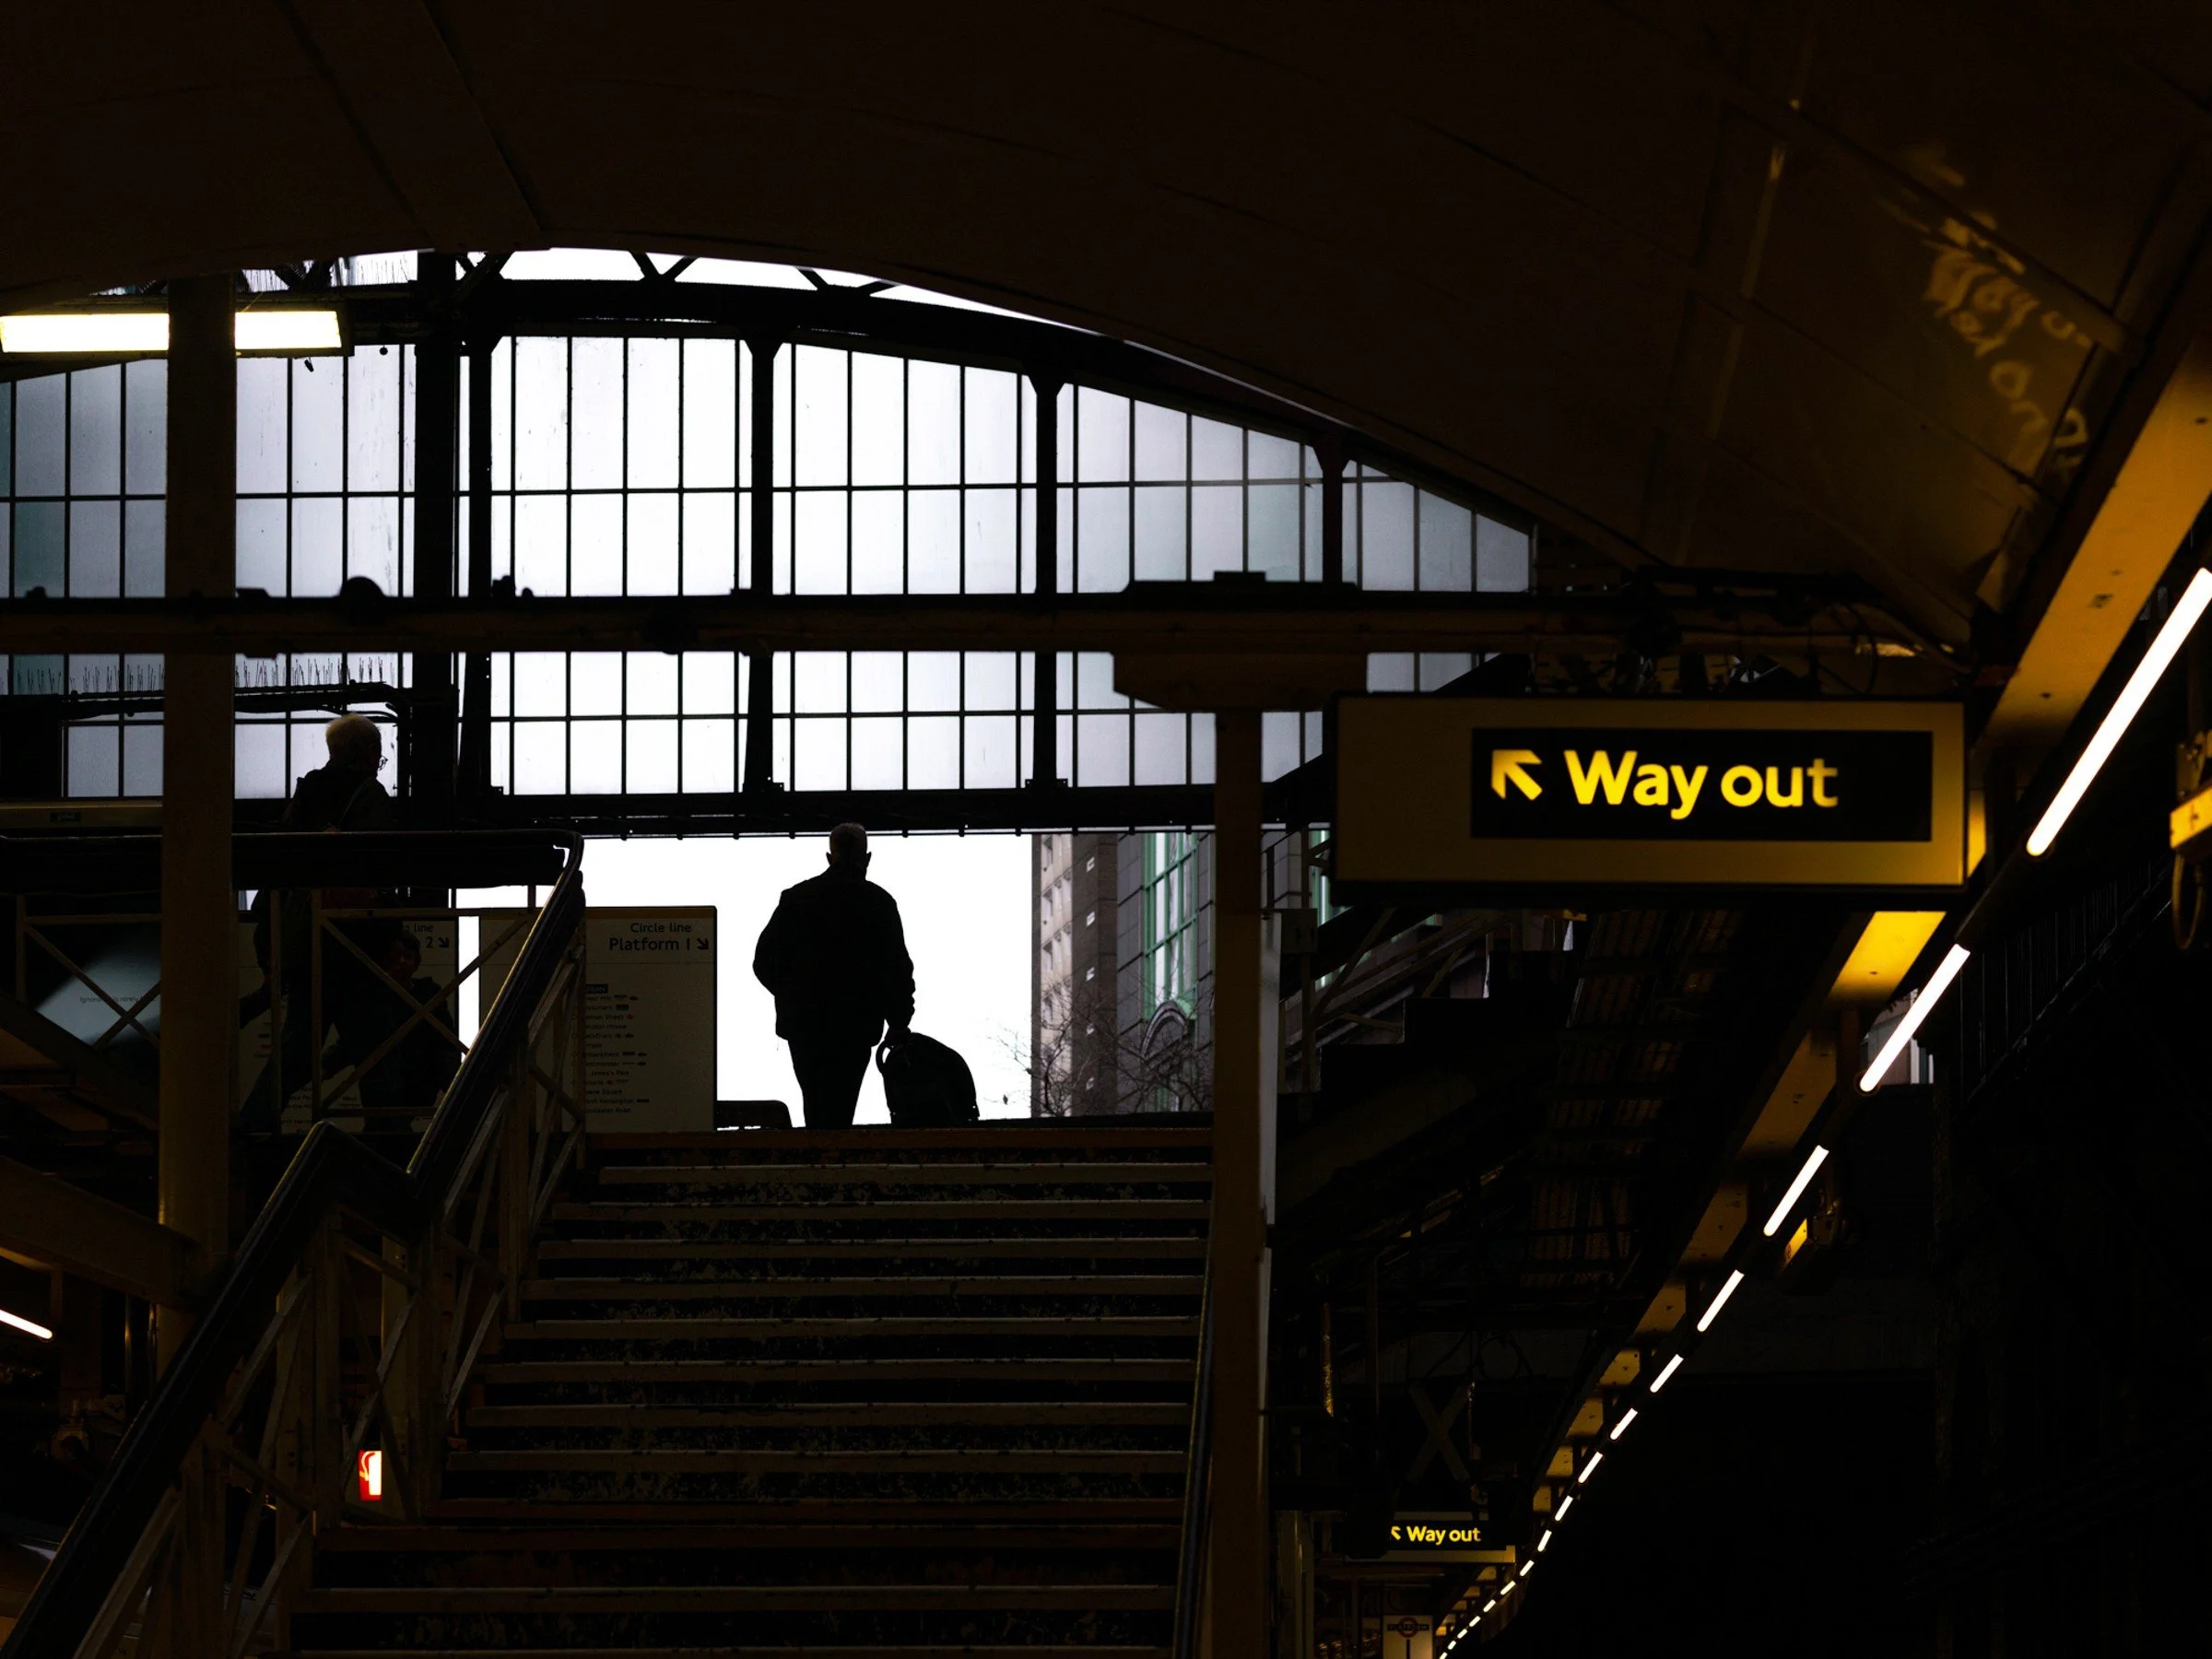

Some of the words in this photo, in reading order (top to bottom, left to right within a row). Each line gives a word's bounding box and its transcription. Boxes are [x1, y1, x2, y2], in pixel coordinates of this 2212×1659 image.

[1564, 750, 1709, 820] Way
[1721, 759, 1839, 807] out
[414, 923, 434, 933] line
[630, 923, 665, 933] Circle
[669, 923, 691, 933] line
[426, 936, 433, 948] 2
[609, 937, 679, 951] Platform
[1406, 1525, 1446, 1546] Way
[1449, 1527, 1482, 1542] out
